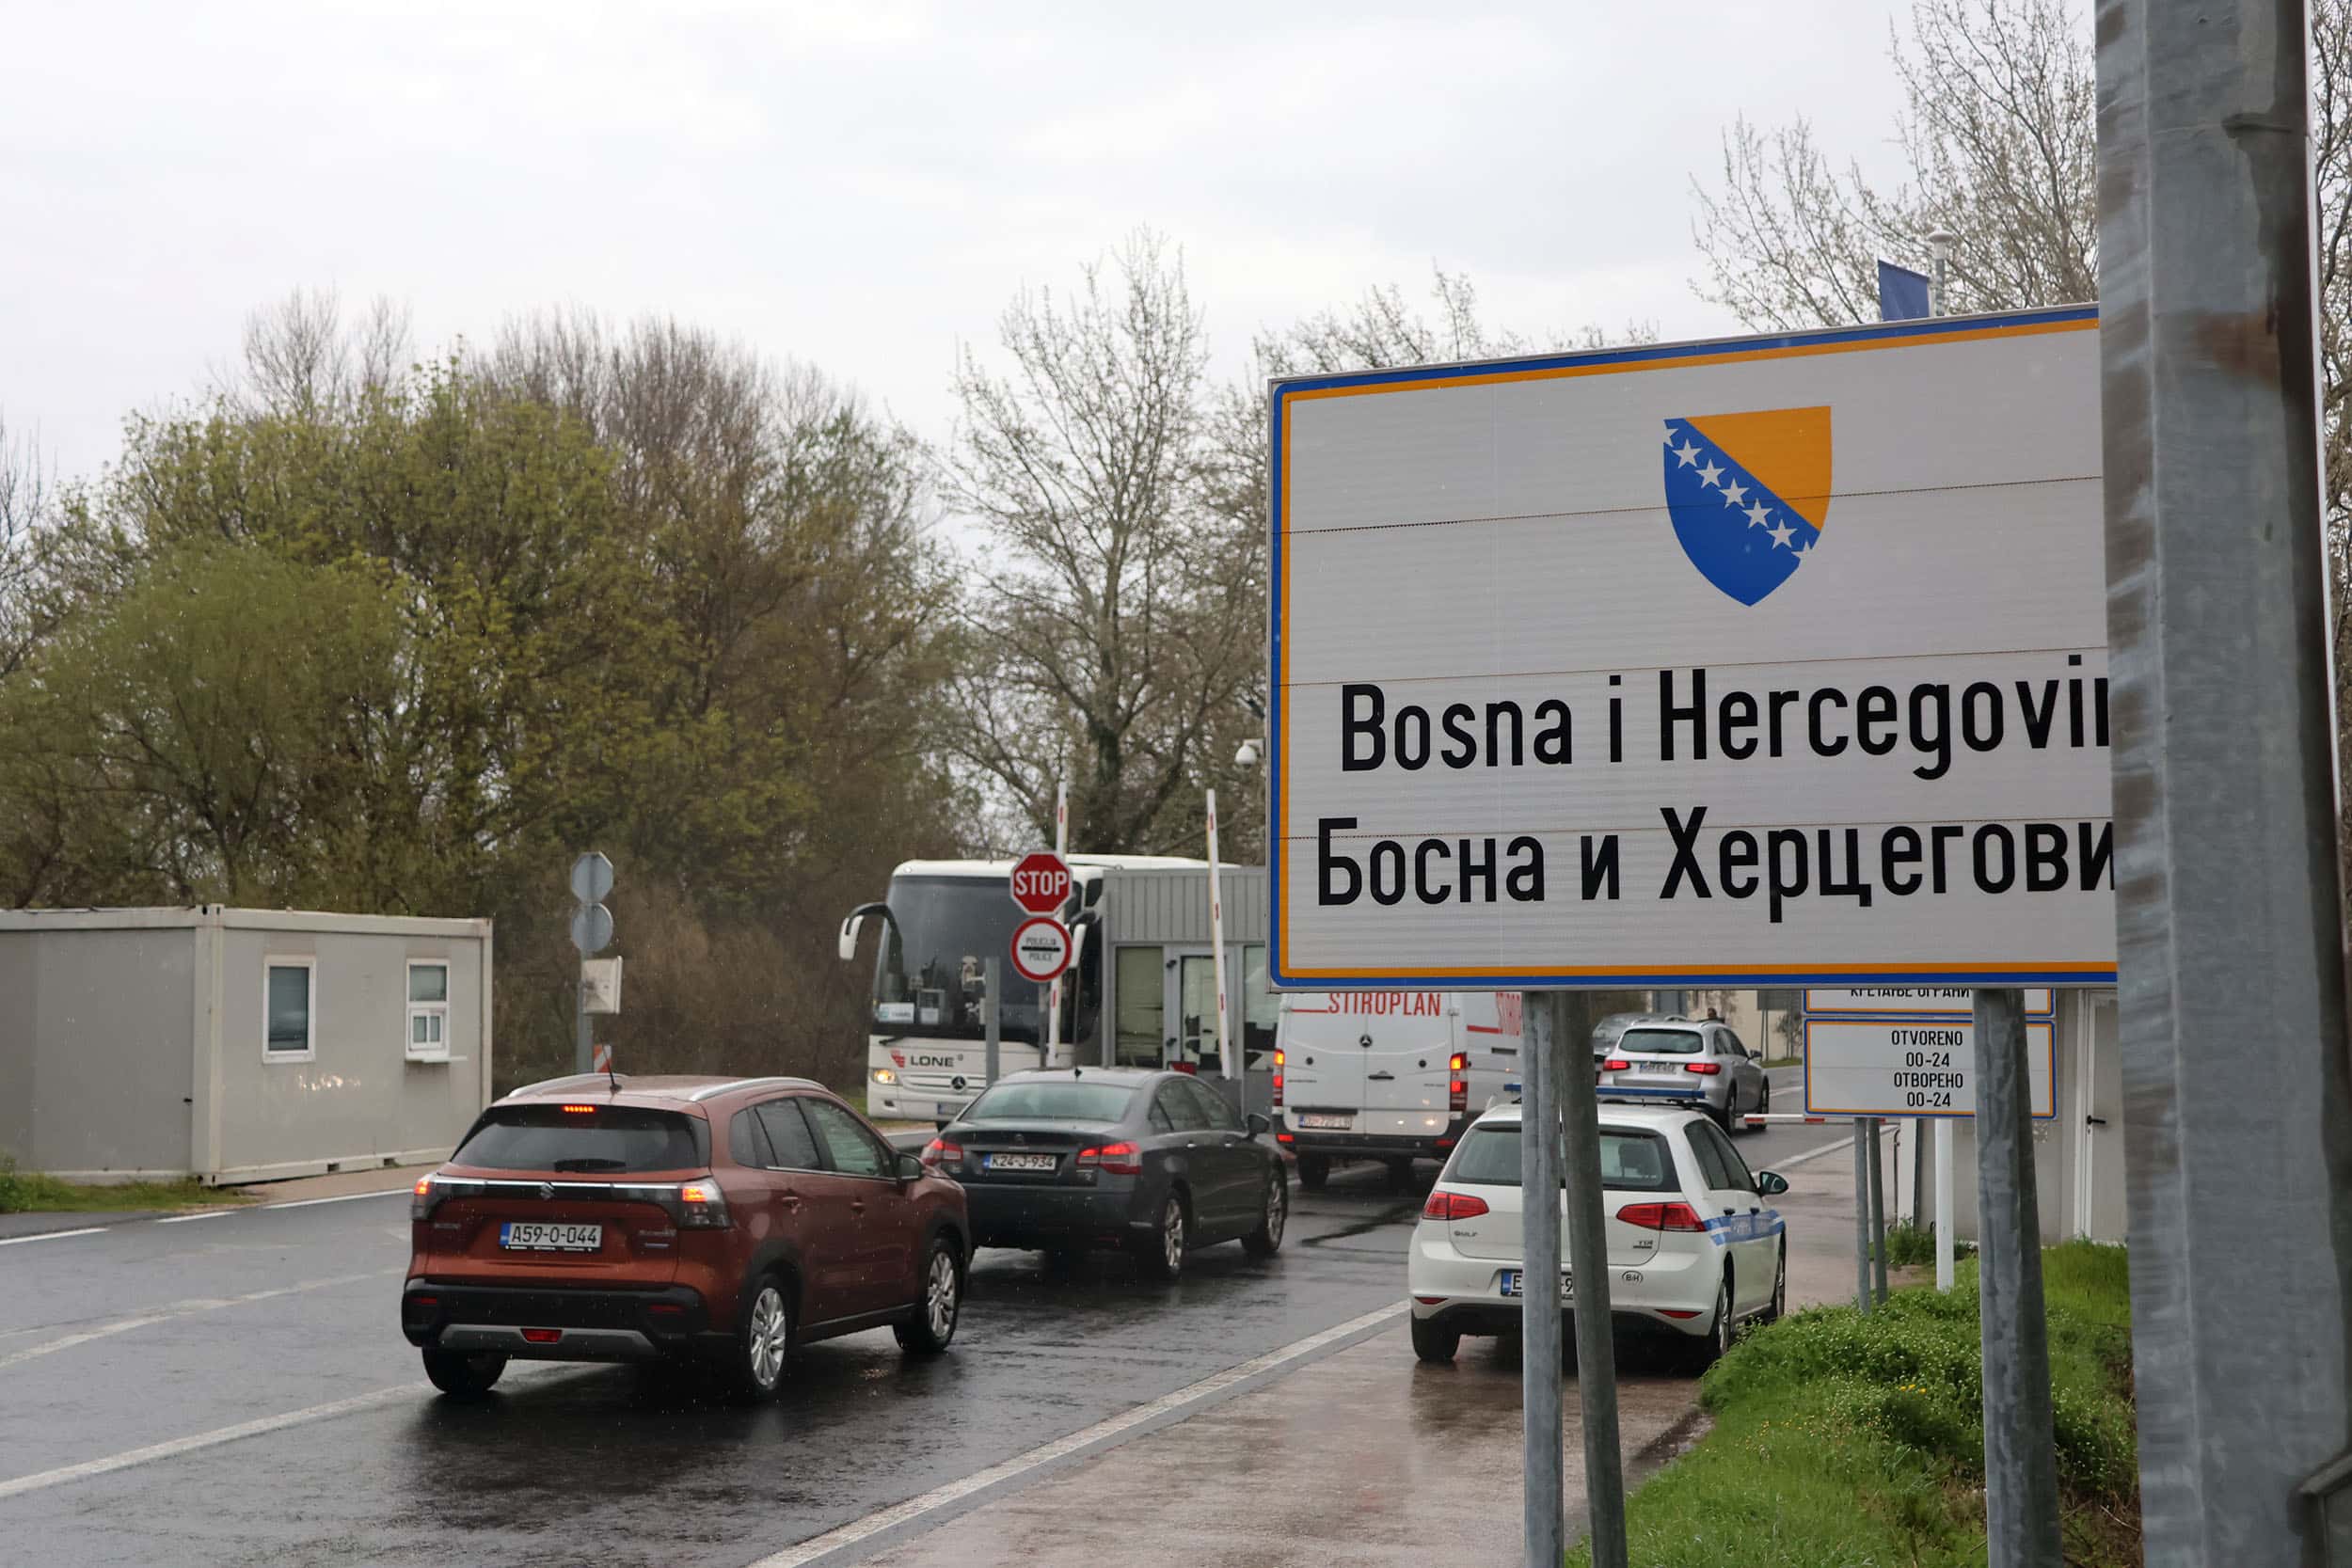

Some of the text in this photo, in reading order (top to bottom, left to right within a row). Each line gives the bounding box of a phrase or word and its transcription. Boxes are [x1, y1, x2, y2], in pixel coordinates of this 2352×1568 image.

[1342, 683, 1572, 771] Bosna
[1609, 674, 1622, 763] i
[1318, 816, 1545, 906] Босна
[1581, 834, 1620, 901] и
[1015, 870, 1068, 896] STOP
[1327, 992, 1441, 1017] STIROPLAN
[1891, 1030, 1963, 1046] OTVORENO
[911, 1054, 955, 1068] LONE
[1905, 1052, 1950, 1068] 00-24
[1893, 1072, 1963, 1088] ОТВОРЕНО
[1906, 1092, 1951, 1107] 00-24
[512, 1226, 597, 1243] A59-O-044
